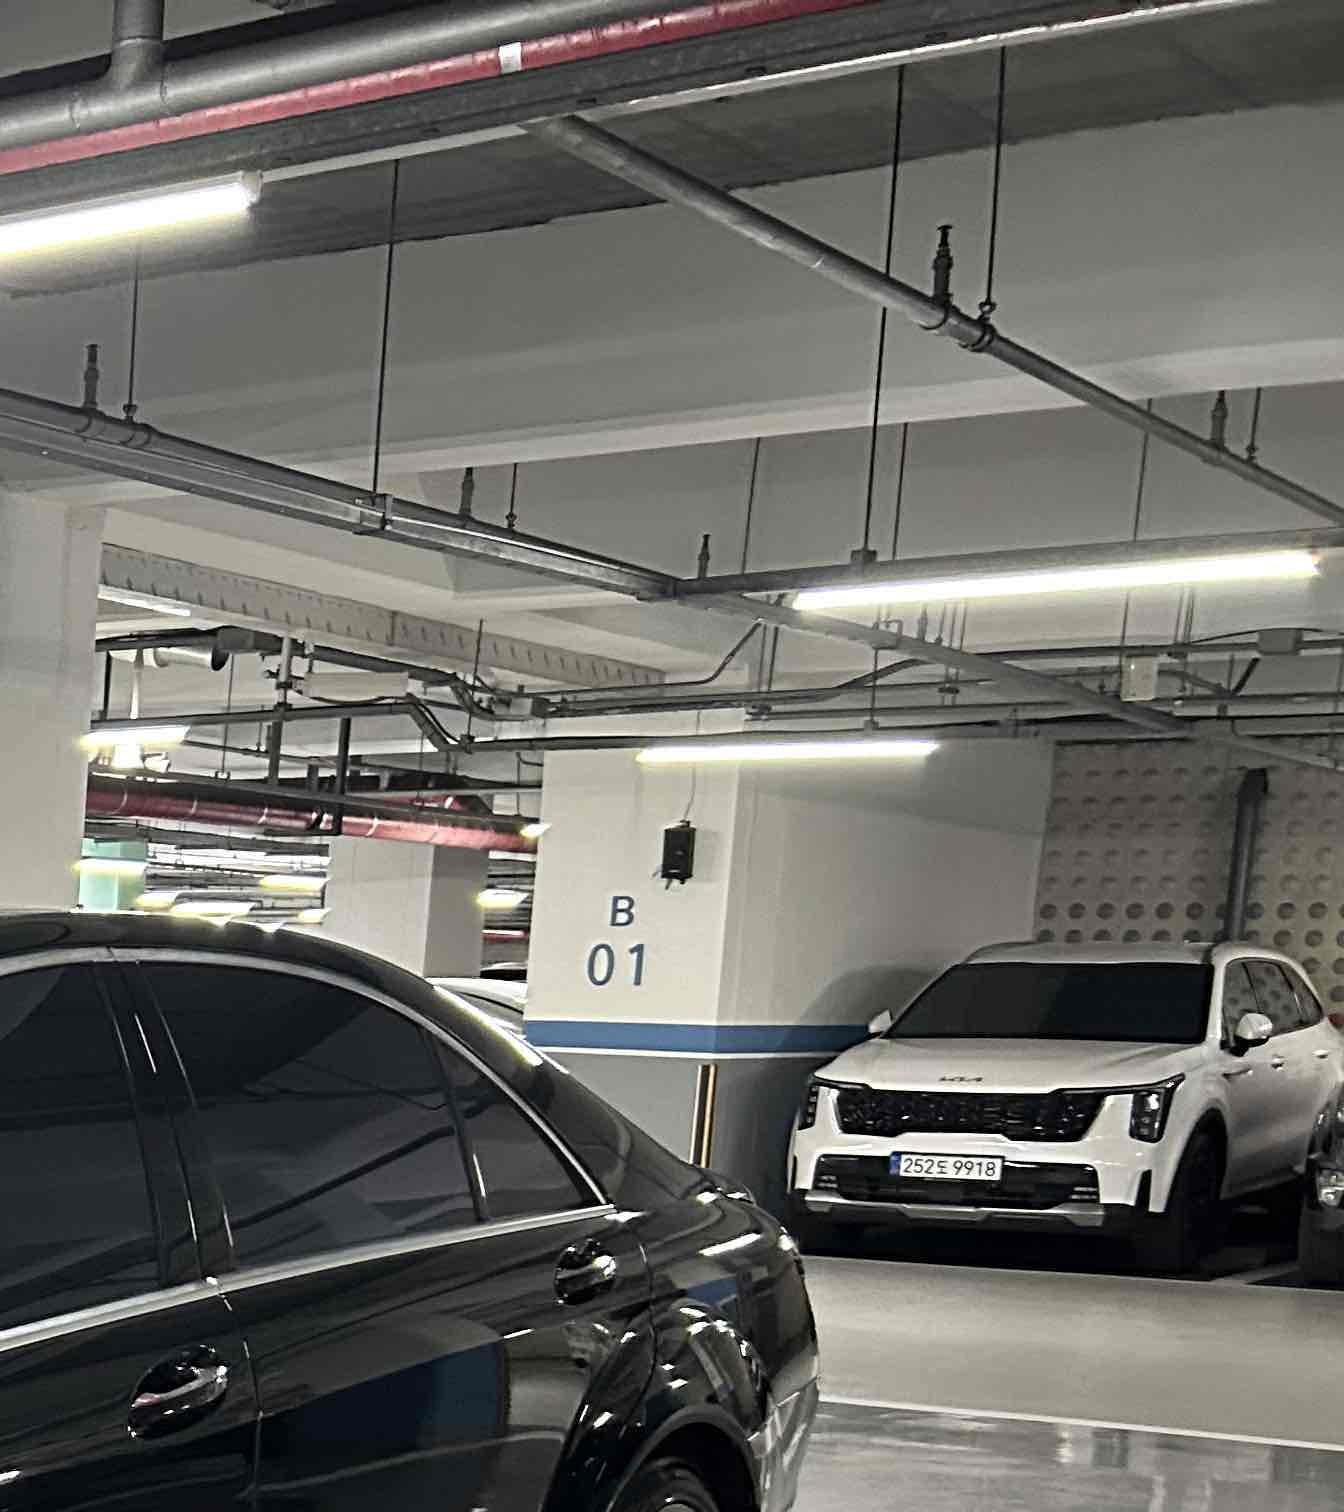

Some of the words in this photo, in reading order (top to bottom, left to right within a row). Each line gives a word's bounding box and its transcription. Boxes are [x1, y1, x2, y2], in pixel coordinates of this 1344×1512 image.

[609, 895, 635, 927] B
[587, 943, 645, 986] 01
[953, 1159, 996, 1177] 9918
